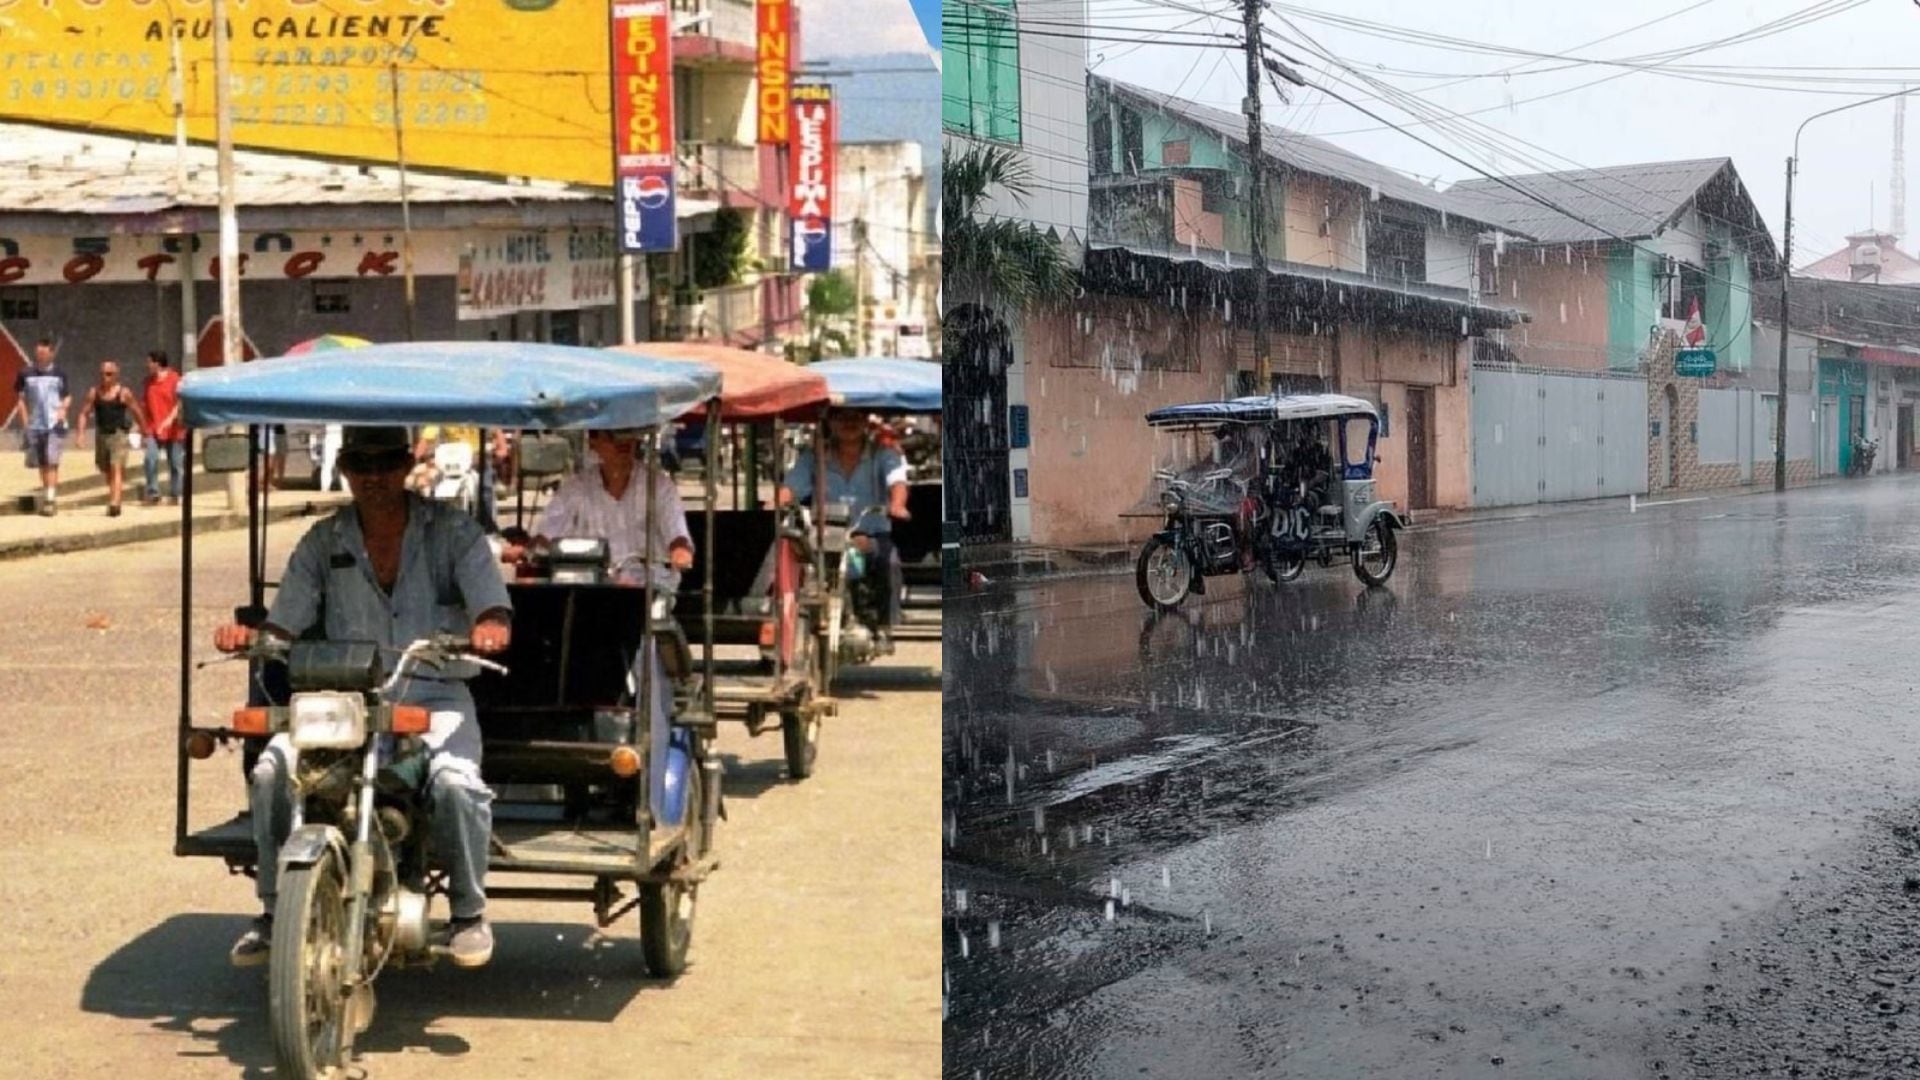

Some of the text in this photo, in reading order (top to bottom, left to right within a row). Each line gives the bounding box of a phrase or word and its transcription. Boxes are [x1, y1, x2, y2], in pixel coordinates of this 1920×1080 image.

[252, 15, 444, 38] CALIENTE
[627, 14, 661, 155] EDINSON
[760, 0, 786, 141] INSON
